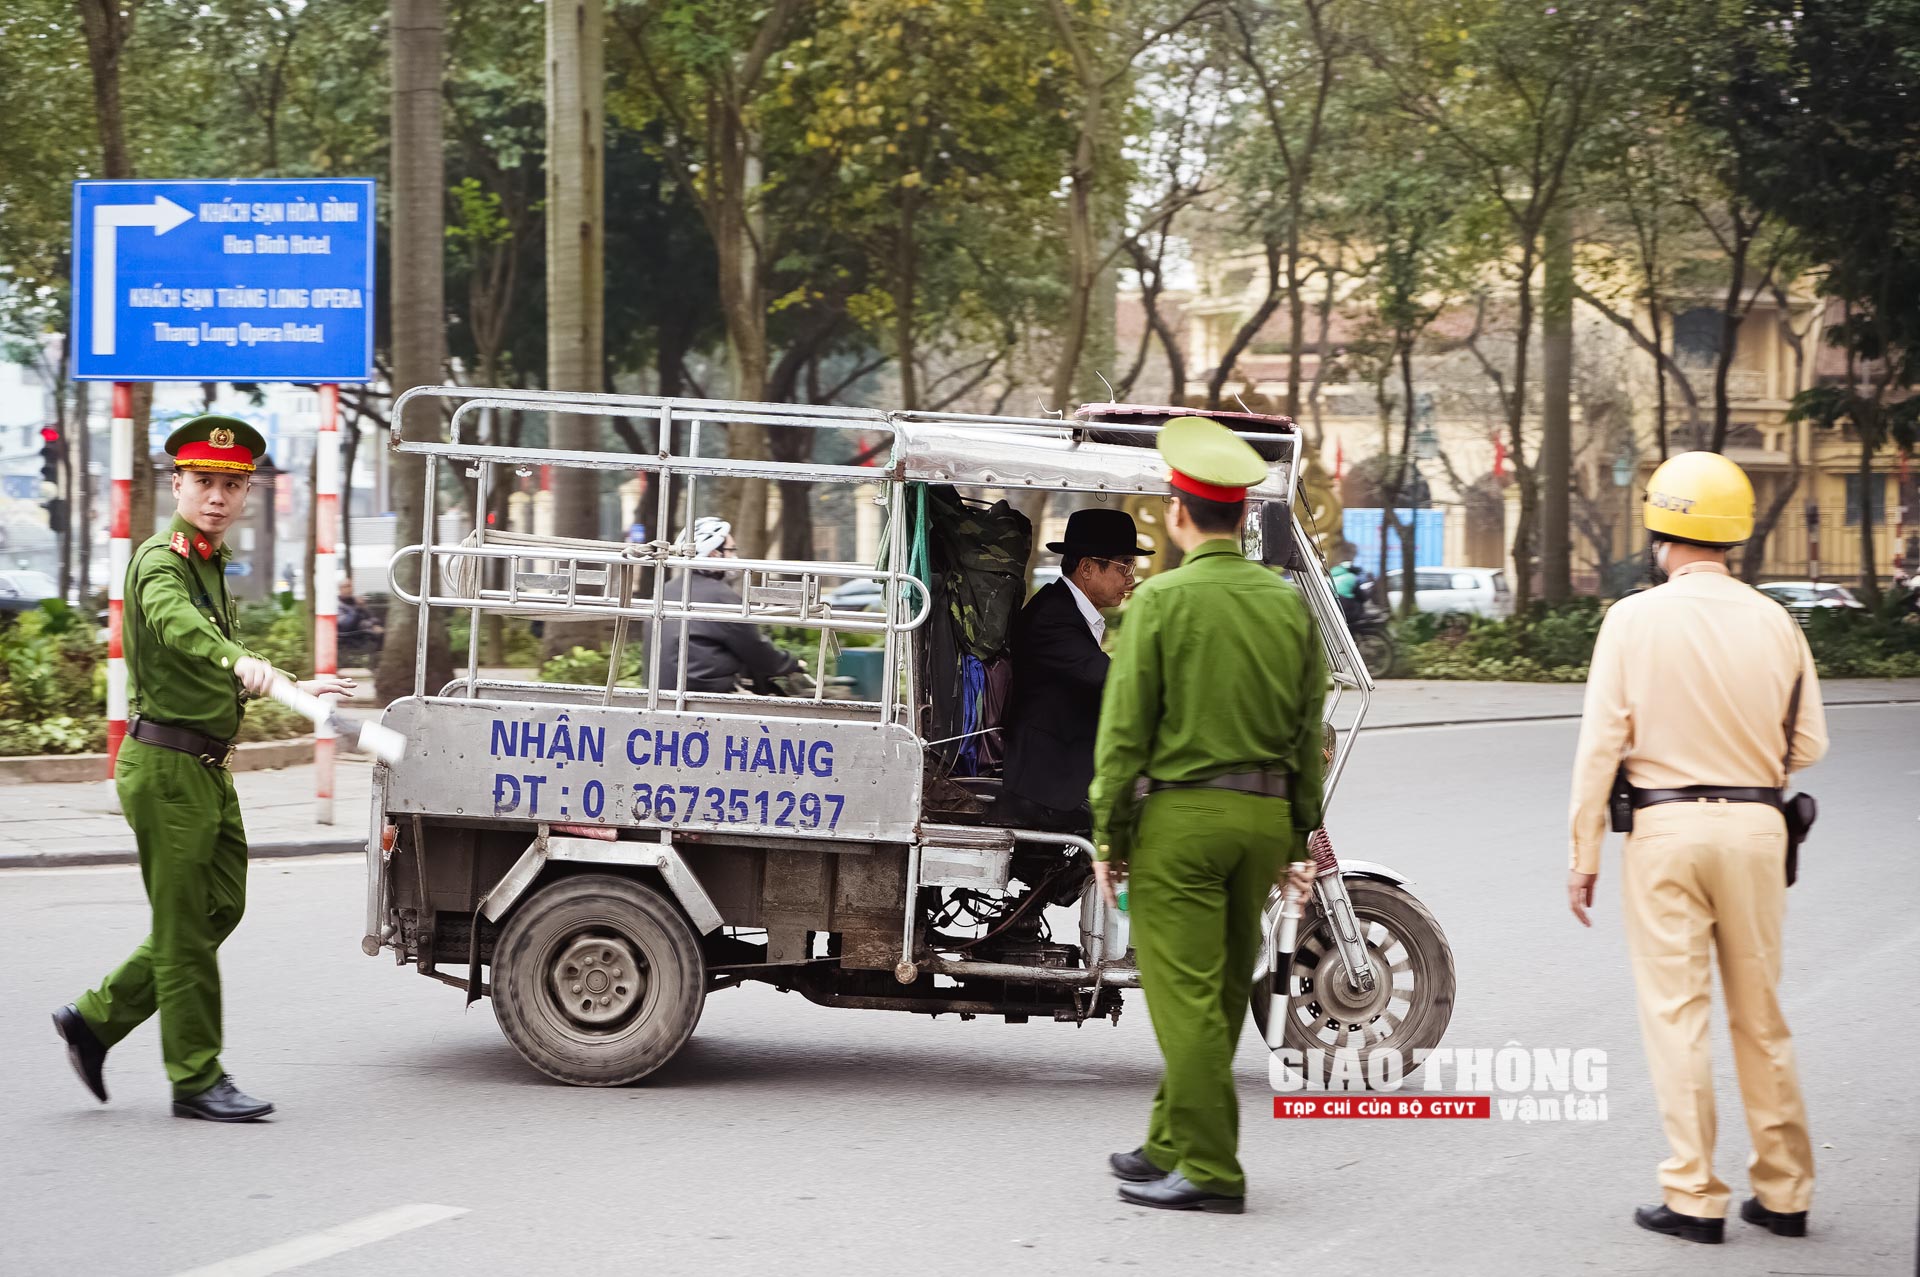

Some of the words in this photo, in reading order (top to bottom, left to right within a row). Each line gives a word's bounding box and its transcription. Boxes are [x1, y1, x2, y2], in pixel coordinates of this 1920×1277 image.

[199, 197, 250, 223] KHÁCH
[251, 203, 285, 226] SẠN
[321, 196, 359, 223] BÌNH
[223, 235, 254, 254] Hoa
[290, 235, 331, 255] Hotel
[129, 282, 181, 308] KHÁCH
[181, 288, 214, 311] SẠN
[268, 288, 309, 308] LONG
[311, 288, 363, 308] OPERA
[201, 322, 238, 347] Long
[239, 322, 283, 347] Opera
[283, 322, 324, 343] Hotel
[490, 714, 605, 769] NHẬN
[724, 725, 834, 778] HÀNG
